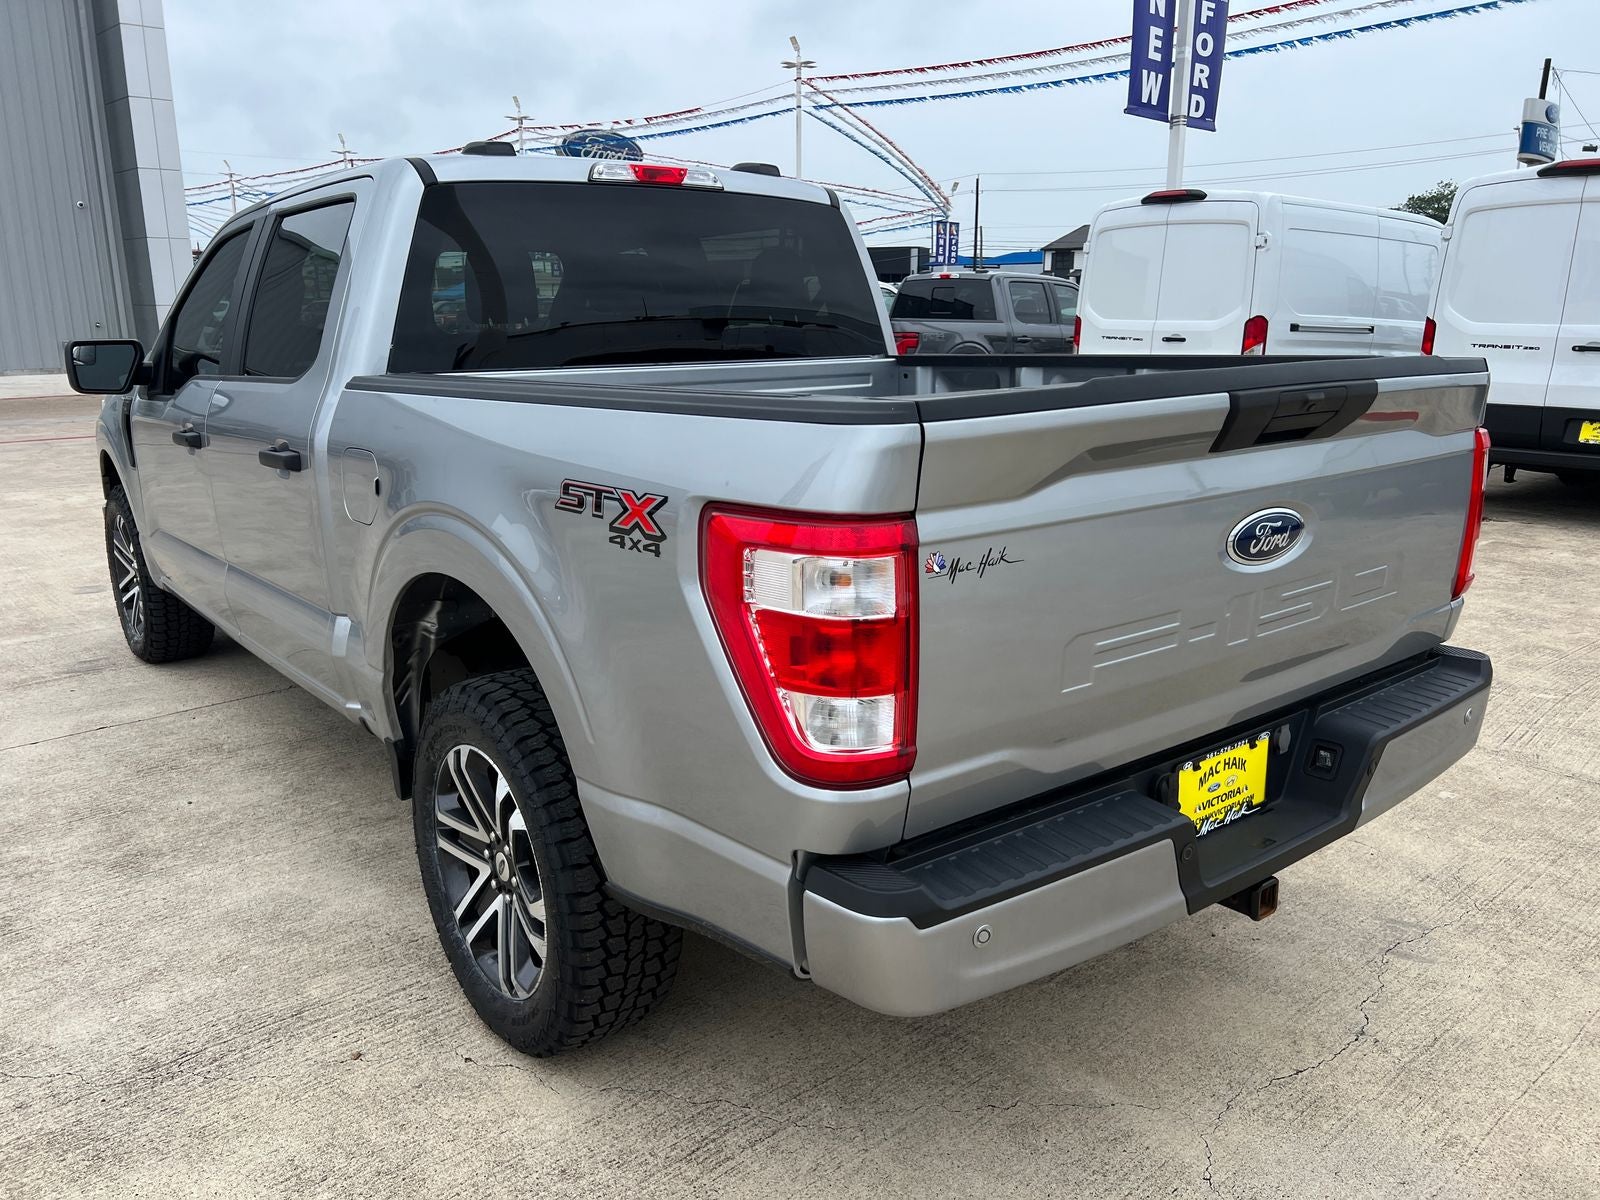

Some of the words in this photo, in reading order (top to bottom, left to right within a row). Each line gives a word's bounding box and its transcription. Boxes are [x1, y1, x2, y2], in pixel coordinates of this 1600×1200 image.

[1188, 1, 1216, 119] FORD
[555, 478, 668, 543] STX
[1249, 520, 1291, 554] Ford
[928, 557, 977, 585] Mac
[977, 546, 1024, 579] Haik
[1061, 557, 1399, 694] F-150
[1198, 761, 1221, 791] MAC
[1223, 756, 1247, 772] HAIK
[1201, 786, 1242, 811] VICTORIA
[1196, 818, 1224, 838] Mac
[1223, 802, 1262, 825] Haik
